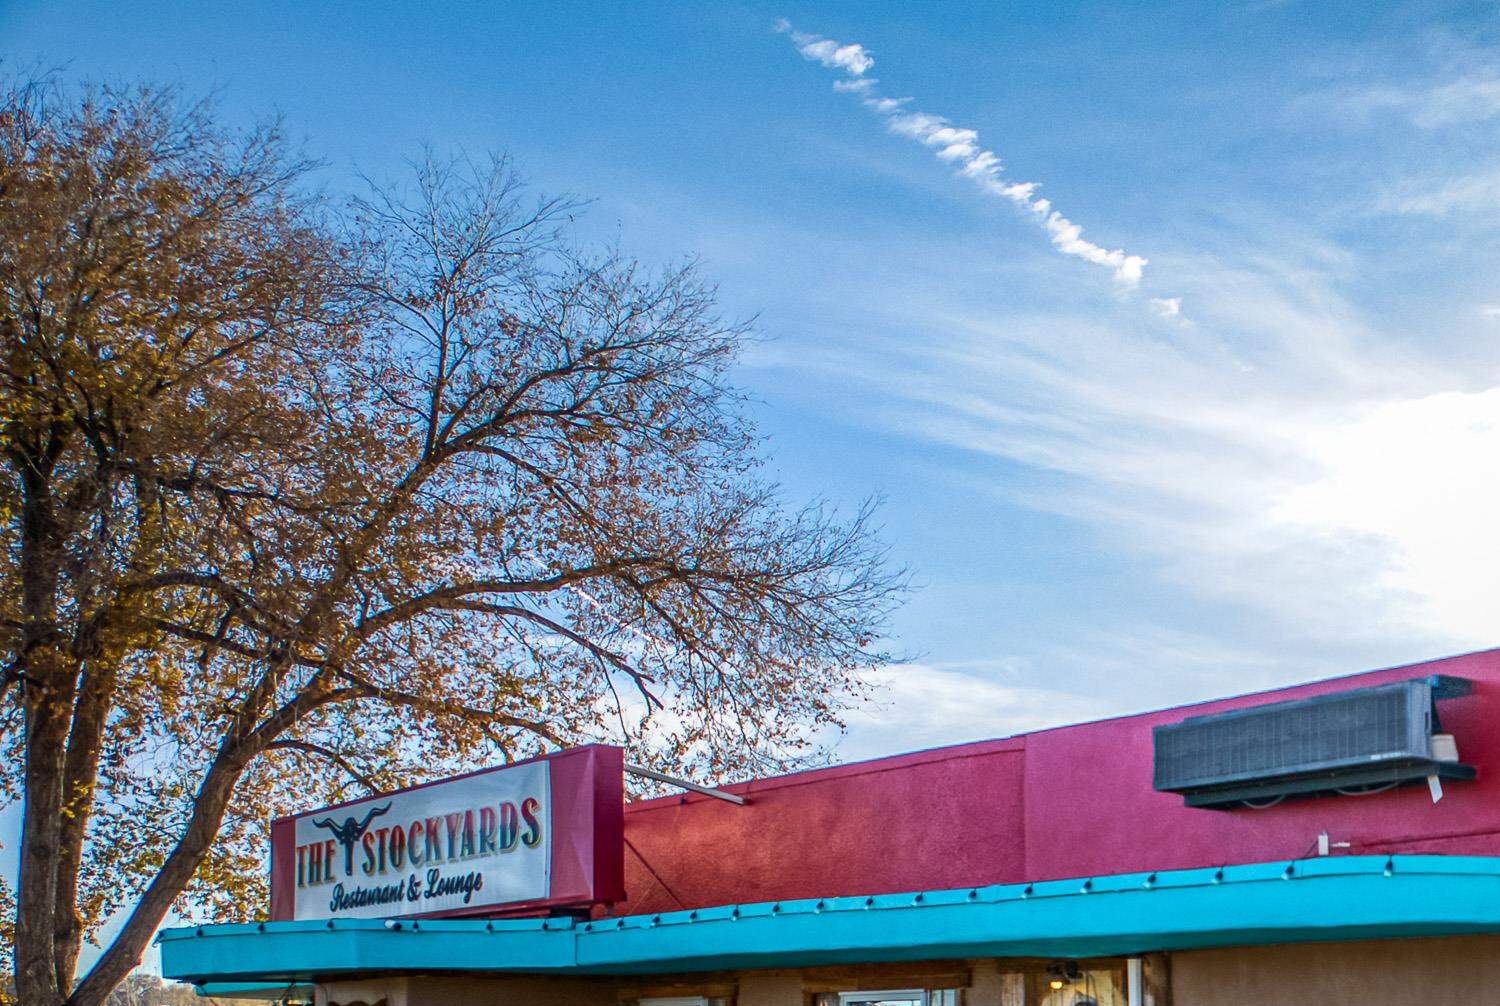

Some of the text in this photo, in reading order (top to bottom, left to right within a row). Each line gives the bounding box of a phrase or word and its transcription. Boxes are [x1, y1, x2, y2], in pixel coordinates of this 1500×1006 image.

[296, 797, 541, 888] THE STOCKYARDS
[330, 868, 483, 912] Restaurant & Lounge
